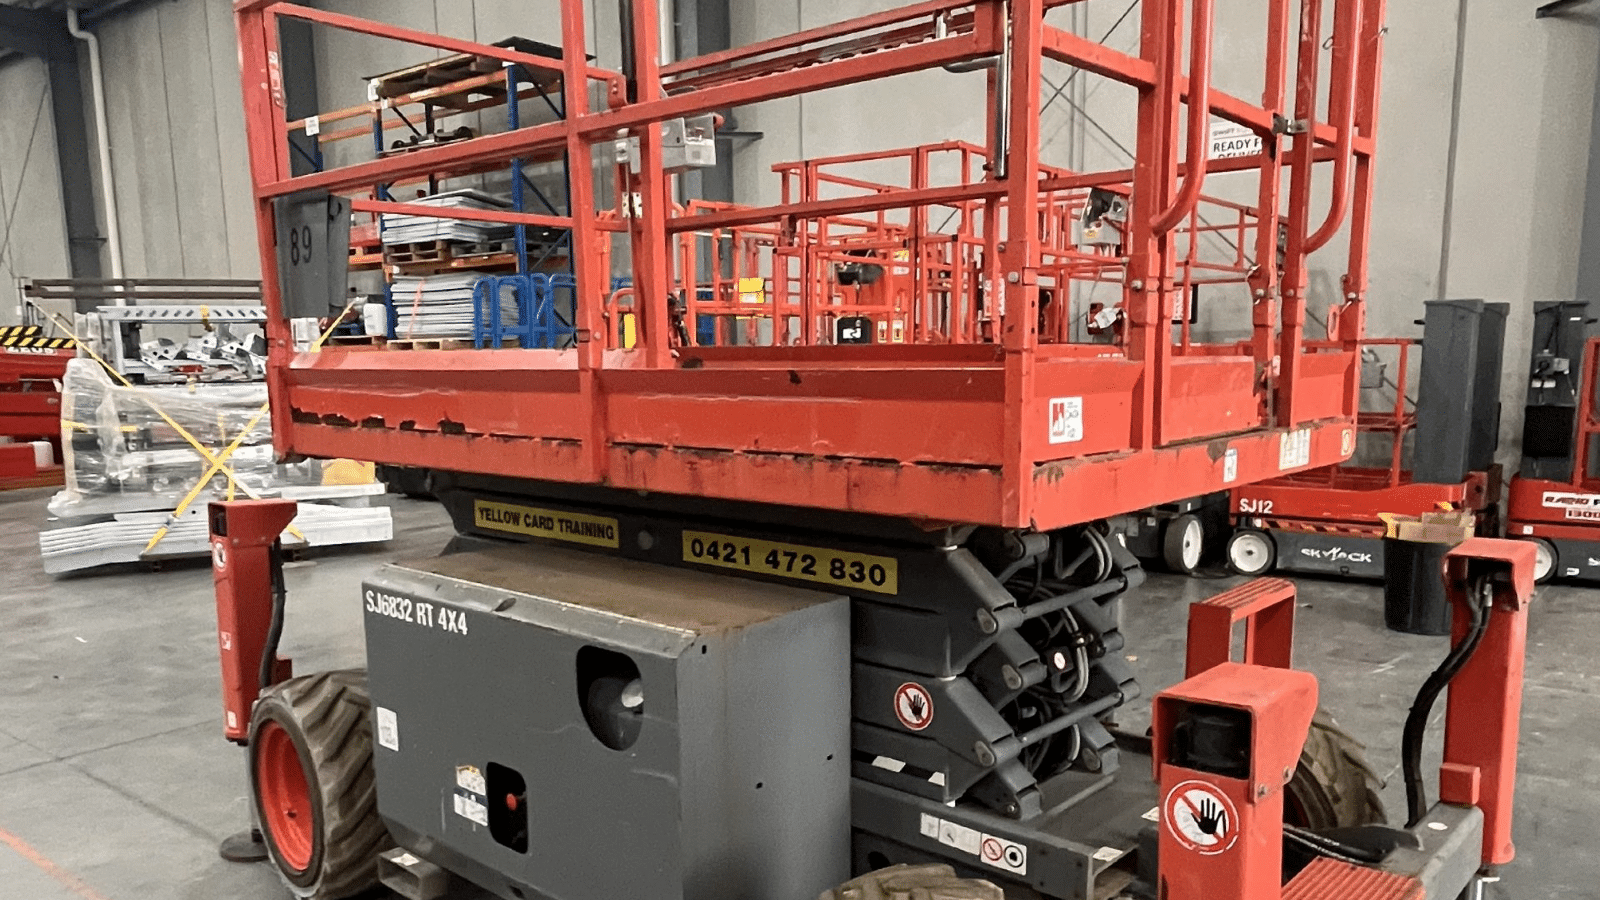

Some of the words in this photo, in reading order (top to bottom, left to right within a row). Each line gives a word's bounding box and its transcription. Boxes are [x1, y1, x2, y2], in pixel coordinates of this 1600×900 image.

[1213, 139, 1251, 152] READY
[291, 225, 312, 266] 89
[1240, 498, 1273, 513] SJ12
[479, 507, 520, 525] YELLOW
[523, 513, 555, 530] CARD
[558, 518, 614, 540] TRAINING
[690, 538, 751, 565] 0421
[765, 549, 817, 577] 472
[829, 558, 886, 586] 830
[1301, 547, 1372, 563] SKYJACK
[366, 590, 413, 622] SJ6832
[416, 602, 433, 627] RT
[438, 607, 468, 635] 4X4
